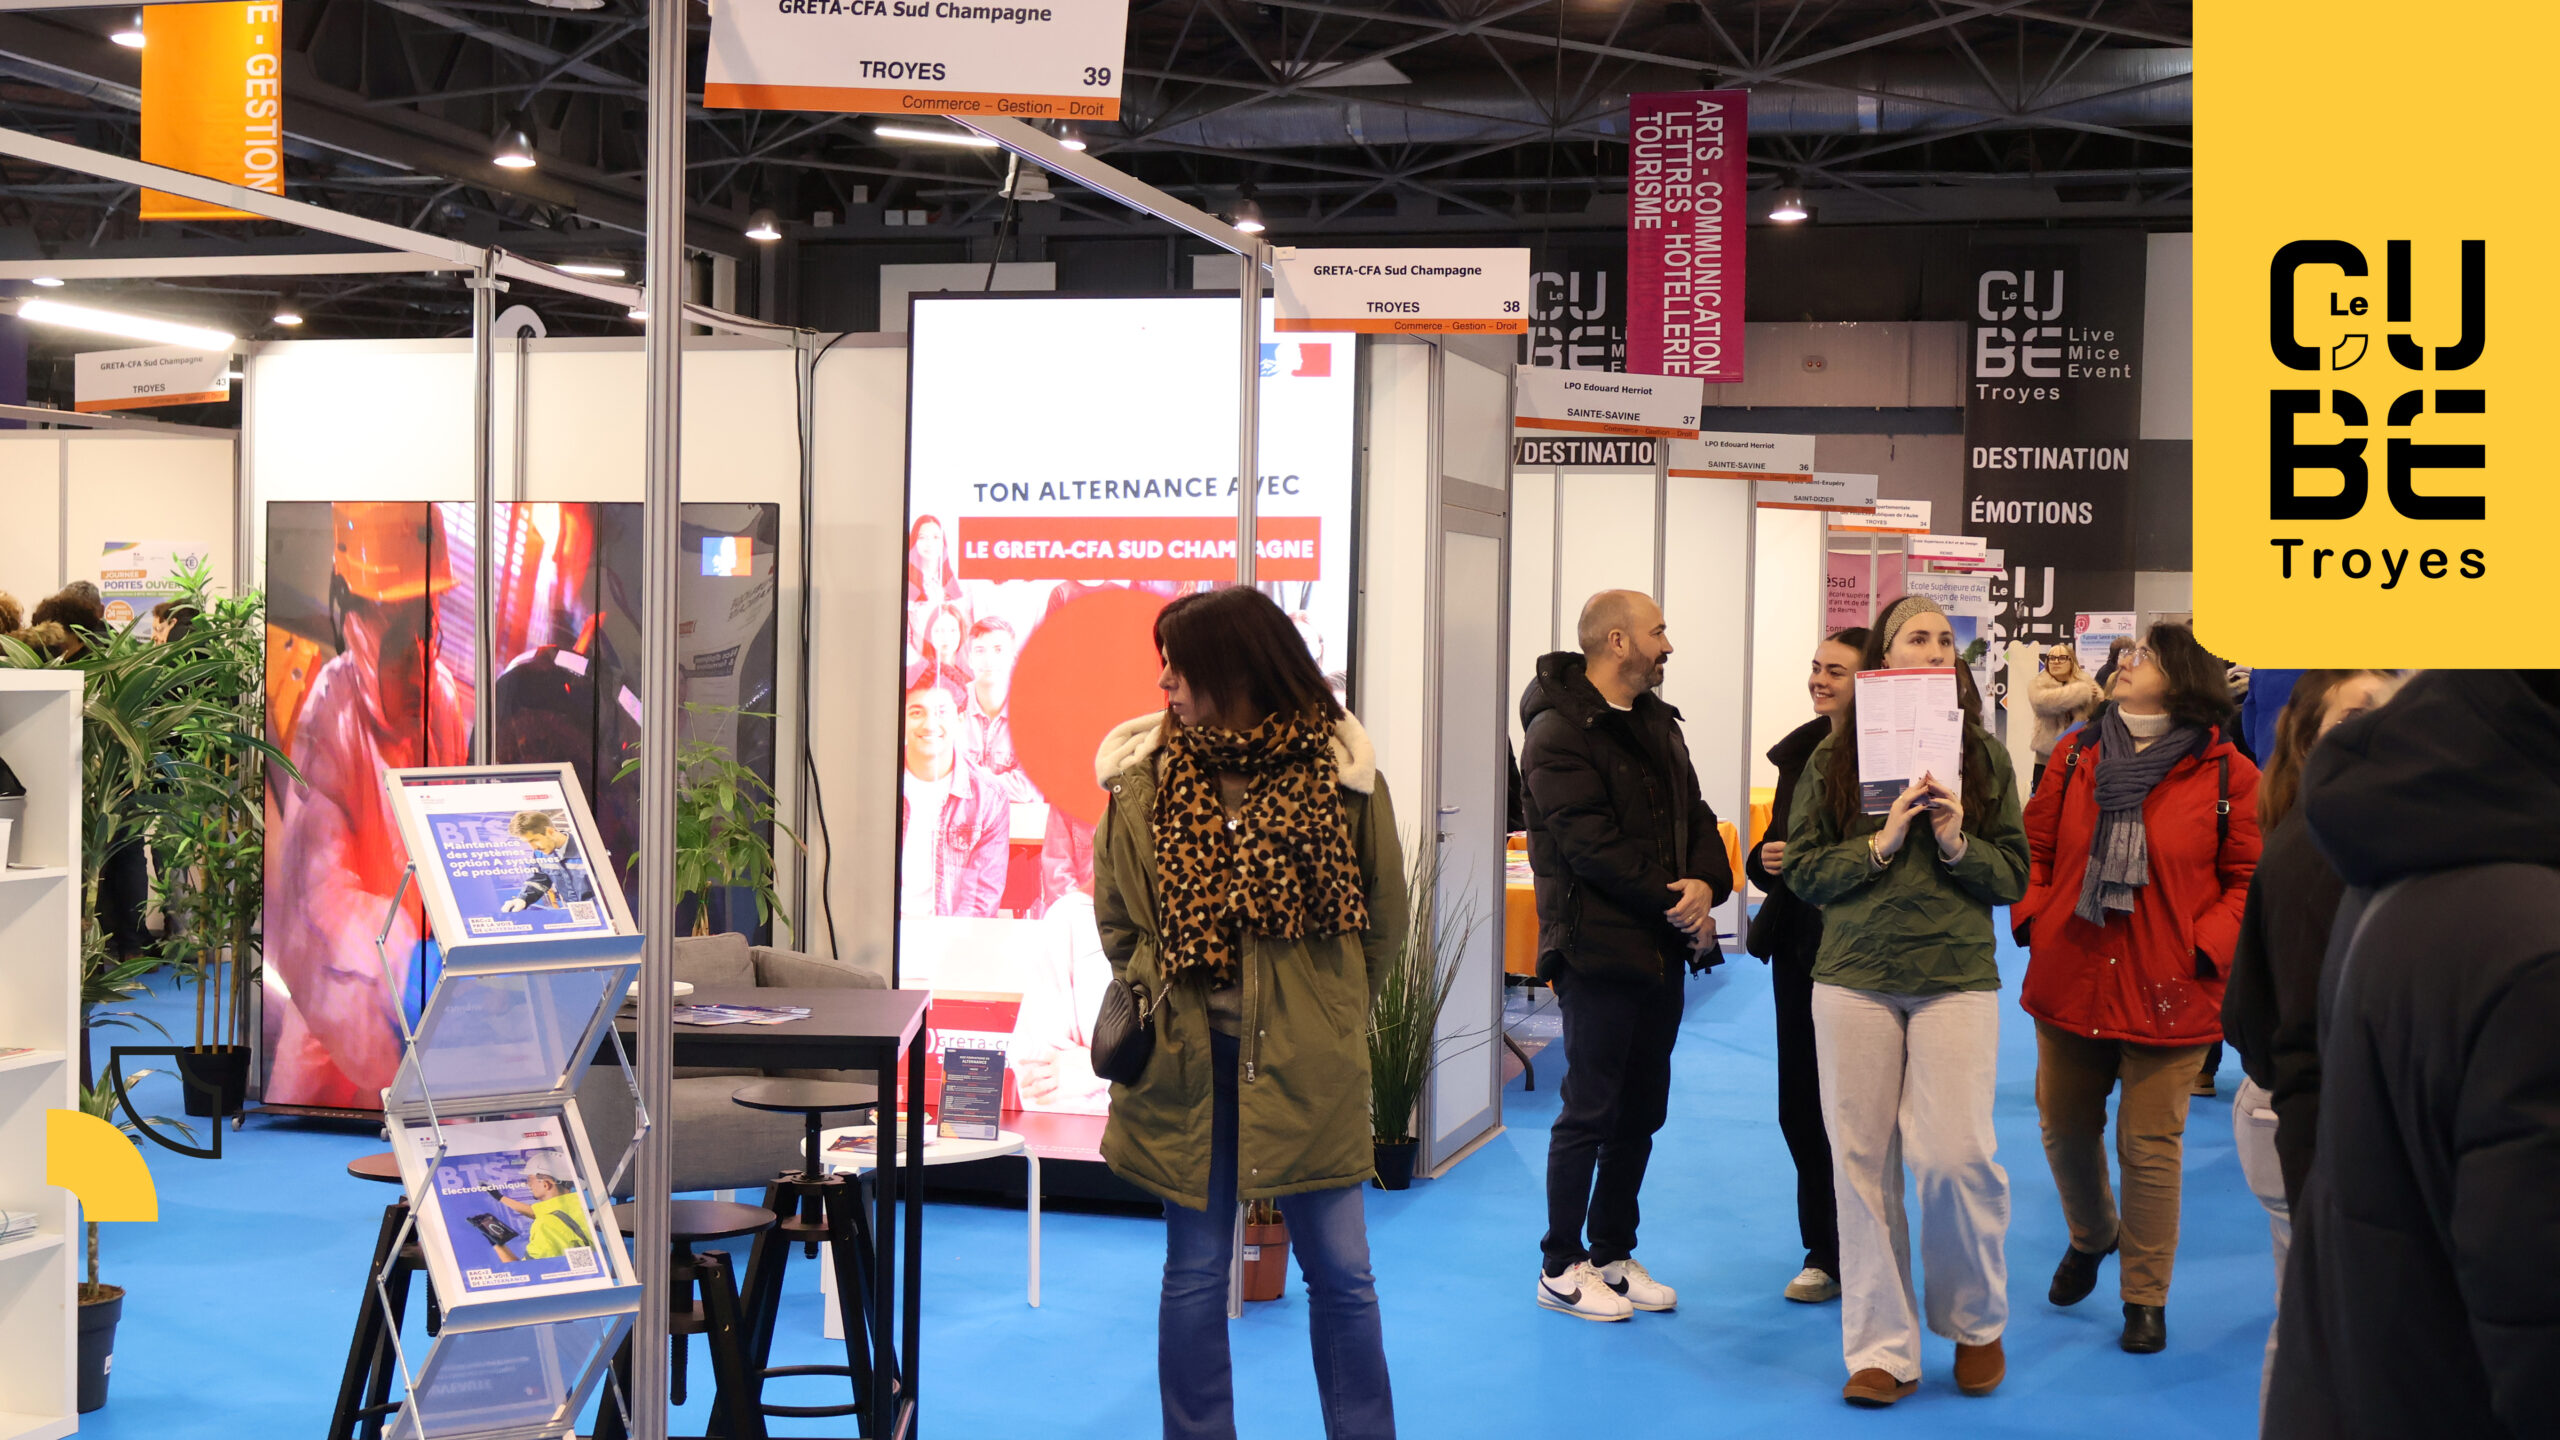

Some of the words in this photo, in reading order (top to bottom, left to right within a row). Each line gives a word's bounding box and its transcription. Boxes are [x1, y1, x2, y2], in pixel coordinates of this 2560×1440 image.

[778, 0, 888, 17] GRETA-CFA
[892, 2, 930, 18] Sud
[935, 3, 1052, 24] Champagne
[859, 60, 946, 81] TROYES
[1082, 66, 1111, 87] 39
[902, 95, 981, 111] Commerce
[997, 98, 1053, 113] Gestion
[1069, 101, 1105, 116] Droit
[244, 53, 278, 192] GESTION
[1696, 100, 1724, 161] ARTS
[1665, 111, 1693, 213] LETTRES
[1634, 111, 1663, 229] TOURISME
[1313, 265, 1382, 276] GRETA-CFA
[1384, 265, 1407, 276] Sud
[1410, 265, 1482, 278] Champagne
[1693, 181, 1723, 375] COMMUNICATION
[1550, 290, 1564, 301] Le
[2002, 290, 2018, 300] Le
[1366, 302, 1420, 313] TROYES
[1503, 301, 1521, 312] 38
[1663, 234, 1691, 375] HOTELLERIE
[1394, 321, 1443, 331] Commerce
[1452, 322, 1486, 331] Gestion
[1496, 321, 1517, 331] Droit
[2069, 328, 2115, 342] Live
[2068, 346, 2120, 360] Mice
[100, 359, 142, 371] GRETA-CFA
[143, 358, 158, 367] Sud
[159, 356, 204, 367] Champagne
[2068, 364, 2131, 378] Event
[133, 384, 166, 394] TROYES
[216, 378, 227, 387] 43
[1564, 382, 1582, 390] LPO
[1584, 383, 1619, 393] Edouard
[1622, 386, 1652, 395] Herriot
[1976, 384, 2061, 404] Troyes
[1567, 408, 1641, 421] SAINTE-SAVINE
[1682, 416, 1695, 425] 37
[1720, 441, 1749, 449] Edouard
[1524, 441, 1656, 464] DESTINATIO
[1972, 447, 2129, 470] DESTINATION
[1708, 461, 1766, 470] SAINTE-SAVINE
[974, 482, 1029, 502] TON
[1039, 477, 1217, 501] ALTERNANCE
[1971, 495, 2093, 525] ÉMOTIONS
[965, 541, 989, 559] LE
[993, 540, 1114, 559] GRETA-CFA
[1118, 540, 1163, 559] SUD
[1168, 539, 1314, 560] CHAMAGNE
[104, 580, 143, 590] PORTES
[145, 580, 182, 590] OUVER
[1992, 586, 2008, 596] Le
[435, 819, 508, 844] BTS
[442, 839, 521, 850] Maintenance
[446, 850, 468, 860] des
[471, 849, 526, 861] systèmes
[449, 858, 490, 871] option
[493, 858, 503, 867] A
[505, 854, 560, 868] systèmes
[453, 868, 469, 878] de
[471, 865, 540, 879] production
[436, 1162, 508, 1188] BTS
